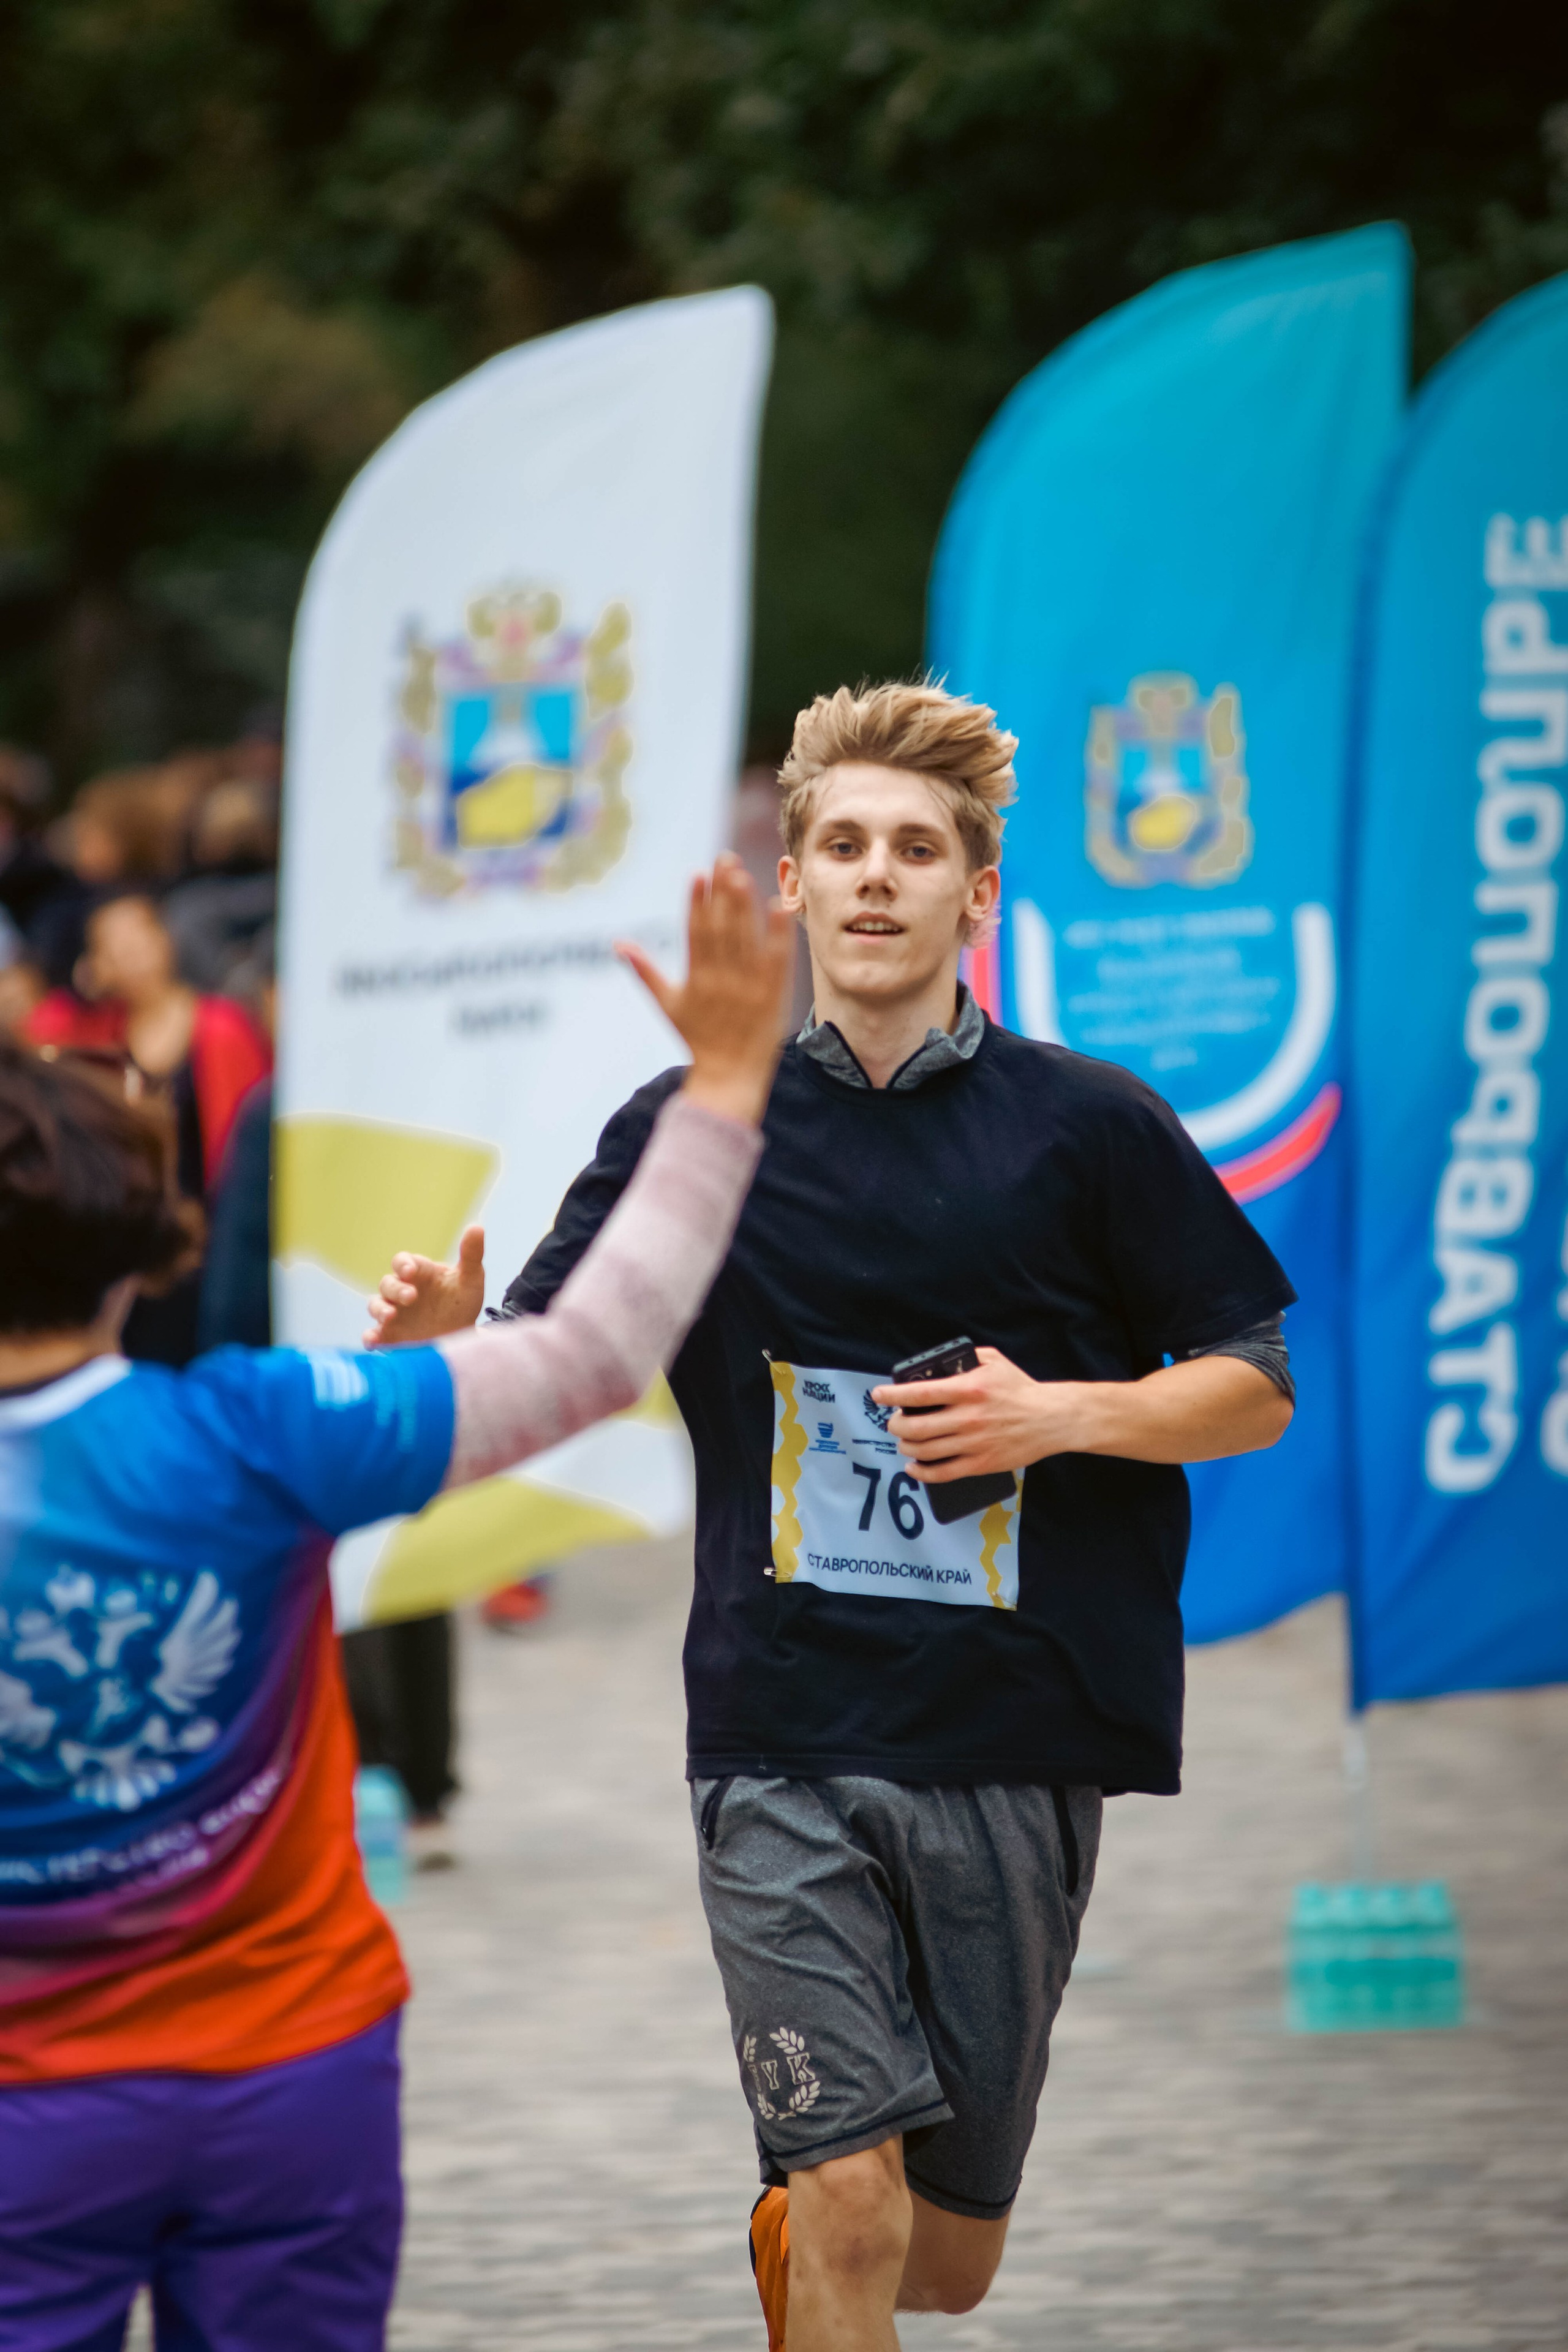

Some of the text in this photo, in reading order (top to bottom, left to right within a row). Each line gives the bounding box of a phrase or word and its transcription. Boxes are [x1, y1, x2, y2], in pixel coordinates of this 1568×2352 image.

[853, 1462, 924, 1540] 76
[808, 1553, 973, 1585] СТАВРОПОЛЬСКИЙ КРАЙ
